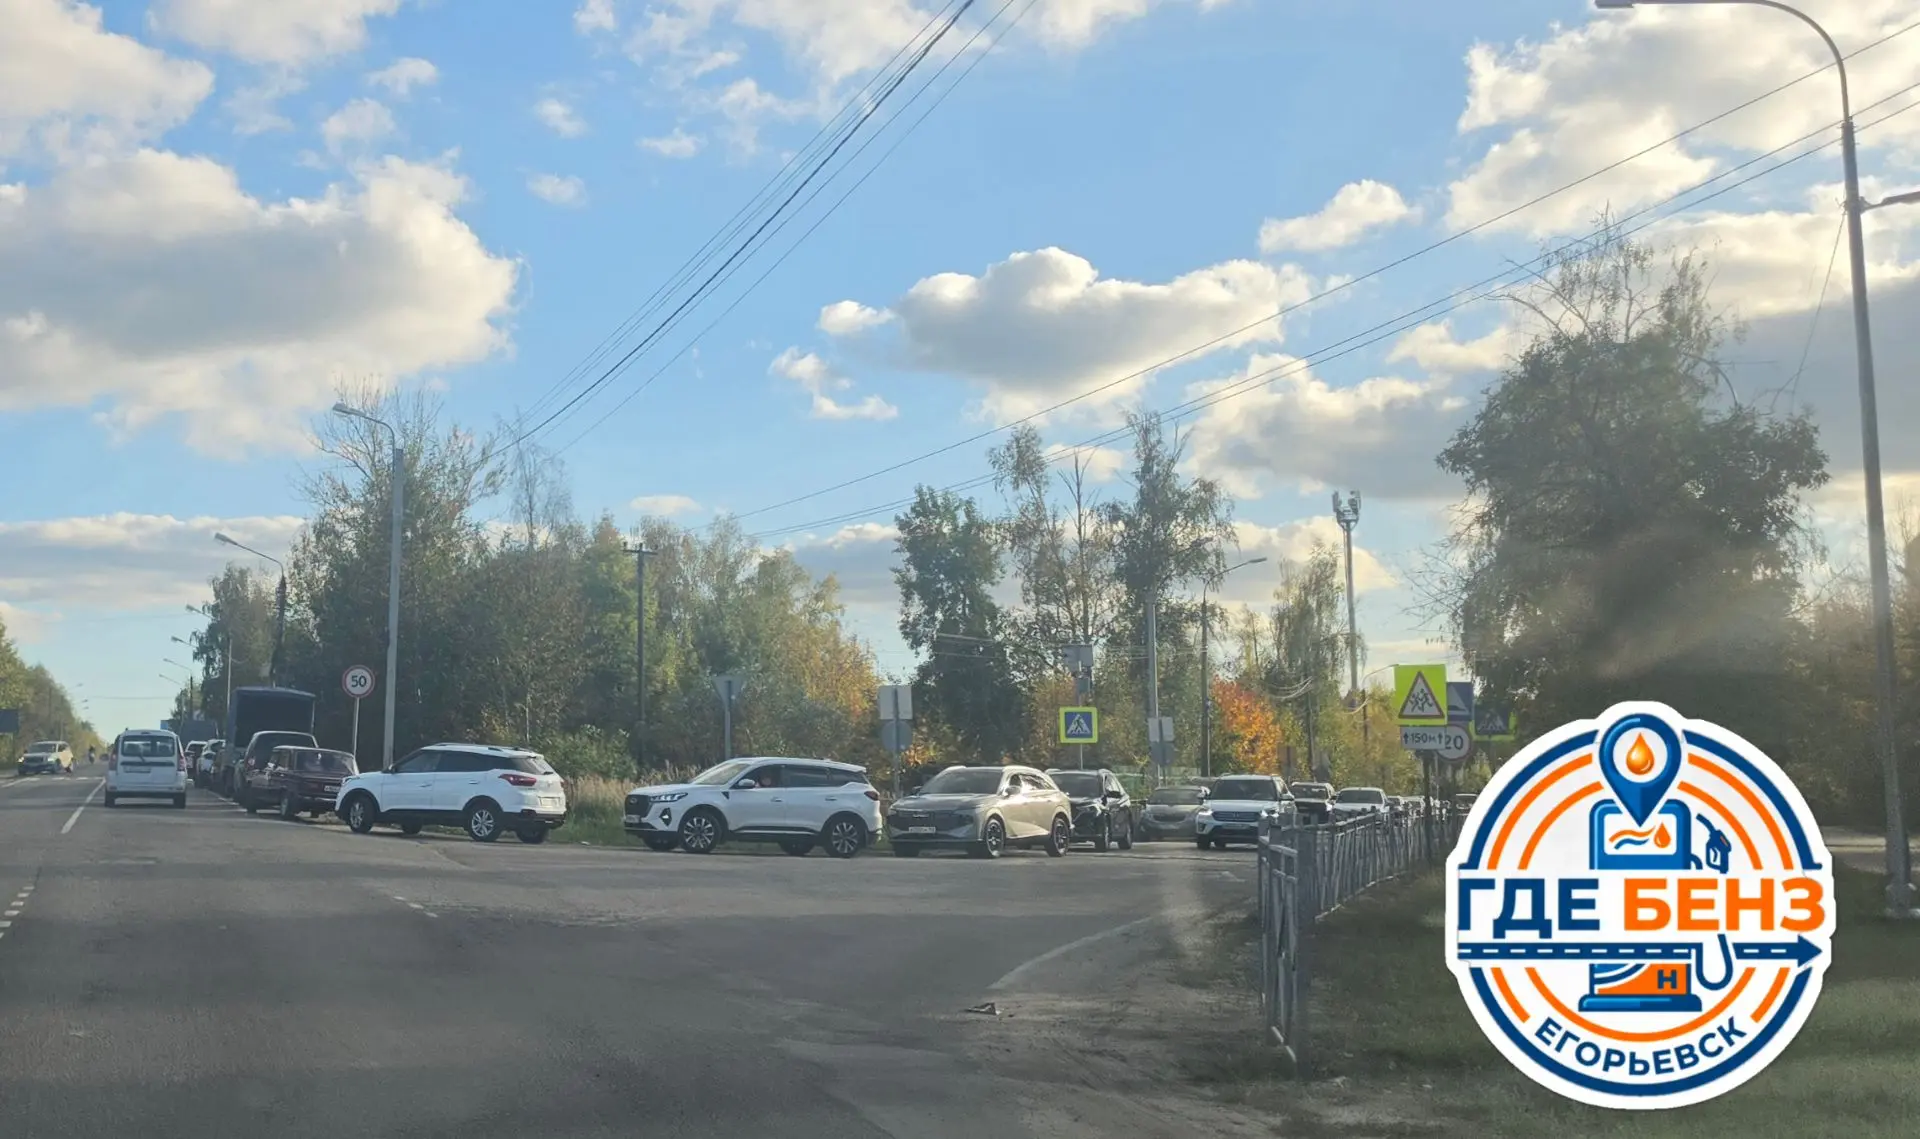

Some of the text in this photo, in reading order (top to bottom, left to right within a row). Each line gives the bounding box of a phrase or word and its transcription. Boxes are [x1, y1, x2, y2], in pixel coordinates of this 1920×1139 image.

[351, 675, 367, 688] 50
[1410, 733, 1436, 744] 150м
[1445, 735, 1463, 750] 20
